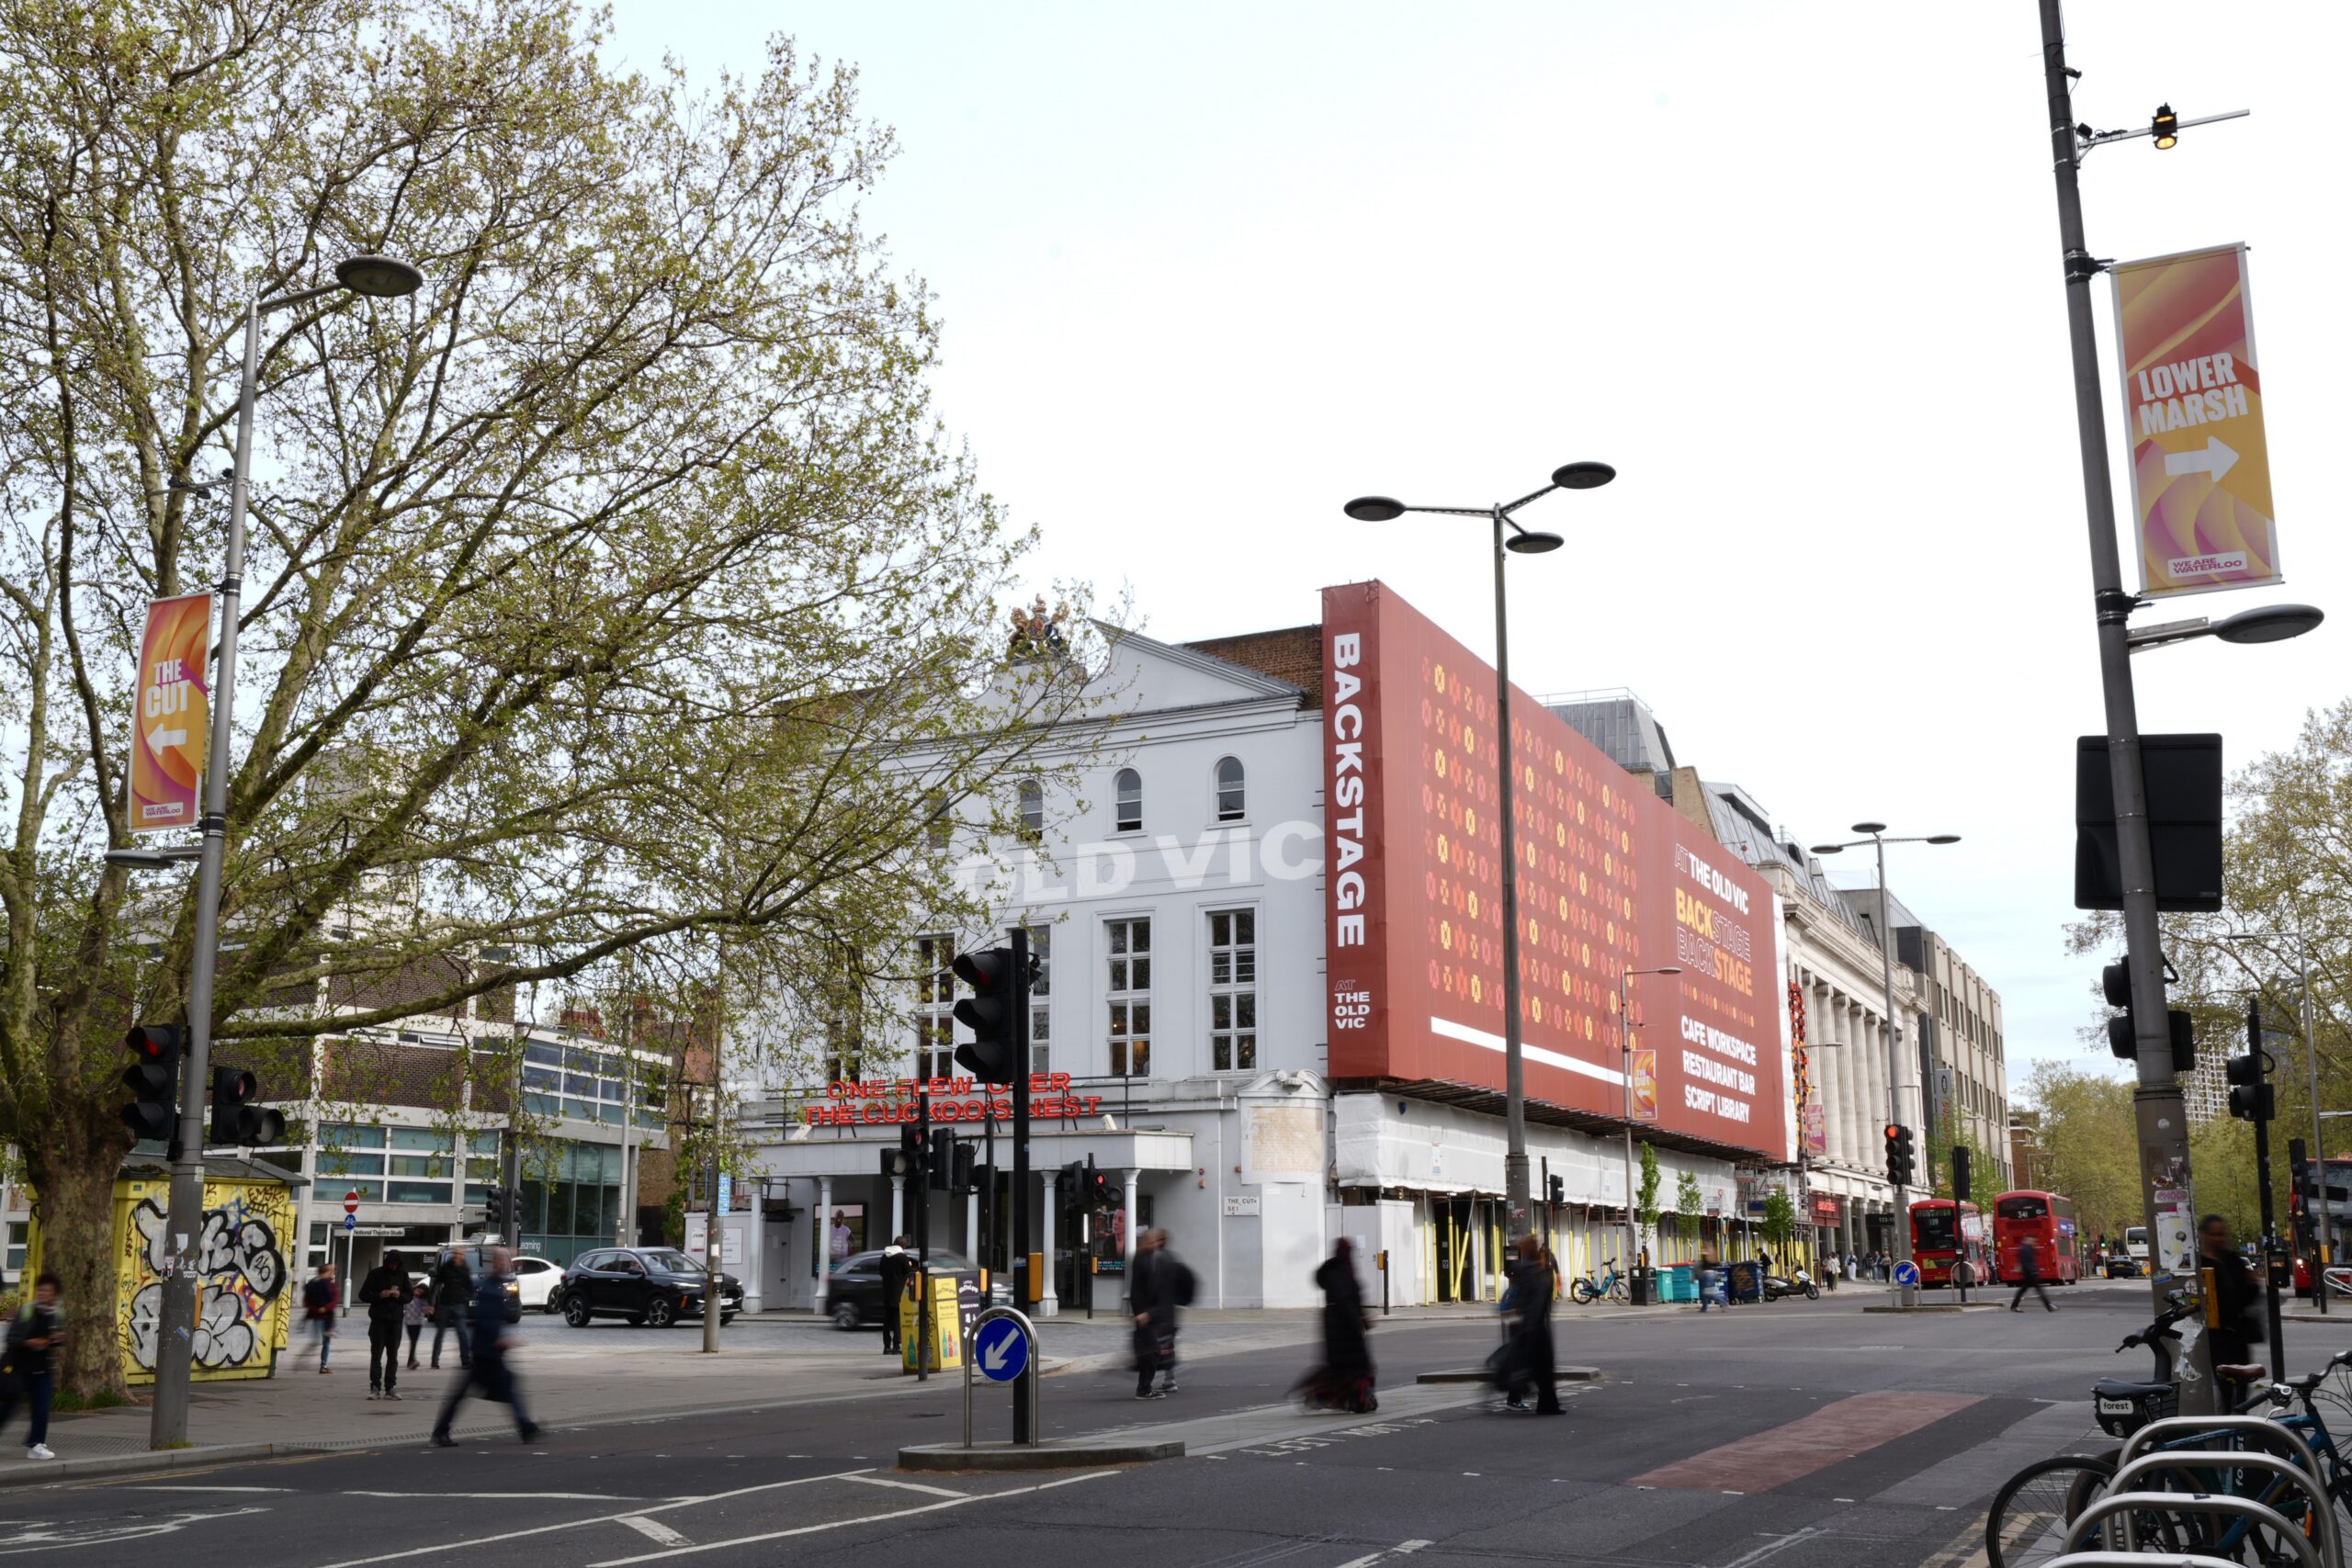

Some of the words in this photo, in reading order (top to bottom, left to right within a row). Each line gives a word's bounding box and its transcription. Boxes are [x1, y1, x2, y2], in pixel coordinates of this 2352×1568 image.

[2138, 352, 2237, 402] LOWER
[2138, 383, 2248, 435] MARSH
[2173, 560, 2188, 569] WE
[2190, 558, 2217, 566] ARE
[2173, 560, 2242, 574] WATERLOO
[154, 659, 183, 684] THE
[145, 680, 191, 718] CUT
[1333, 631, 1365, 948] BACKSTAGE
[145, 808, 181, 817] WATERLOO
[956, 841, 1136, 904] OLD
[1155, 820, 1325, 890] VIC
[1675, 842, 1689, 874] AT
[1689, 852, 1712, 890] THE
[1712, 869, 1733, 904] OLD
[1732, 885, 1749, 916] VIC
[1676, 886, 1751, 964] BACKSTAGE
[1677, 926, 1753, 997] BACKSTAGE
[1334, 991, 1370, 1003] THE
[1335, 979, 1356, 991] AT
[1335, 1004, 1370, 1016] OLD
[1335, 1017, 1366, 1029] VIC
[1681, 1015, 1707, 1046] CAFE
[1706, 1026, 1757, 1066] WORKSPACE
[827, 1079, 887, 1100] ONE
[986, 1072, 1071, 1095] OER
[1682, 1050, 1738, 1089] RESTAURANT
[1738, 1070, 1756, 1095] BAR
[805, 1103, 857, 1125] THE
[1685, 1084, 1715, 1114] SCRIPT
[1716, 1095, 1750, 1123] LIBRARY
[2103, 1402, 2129, 1410] forest
